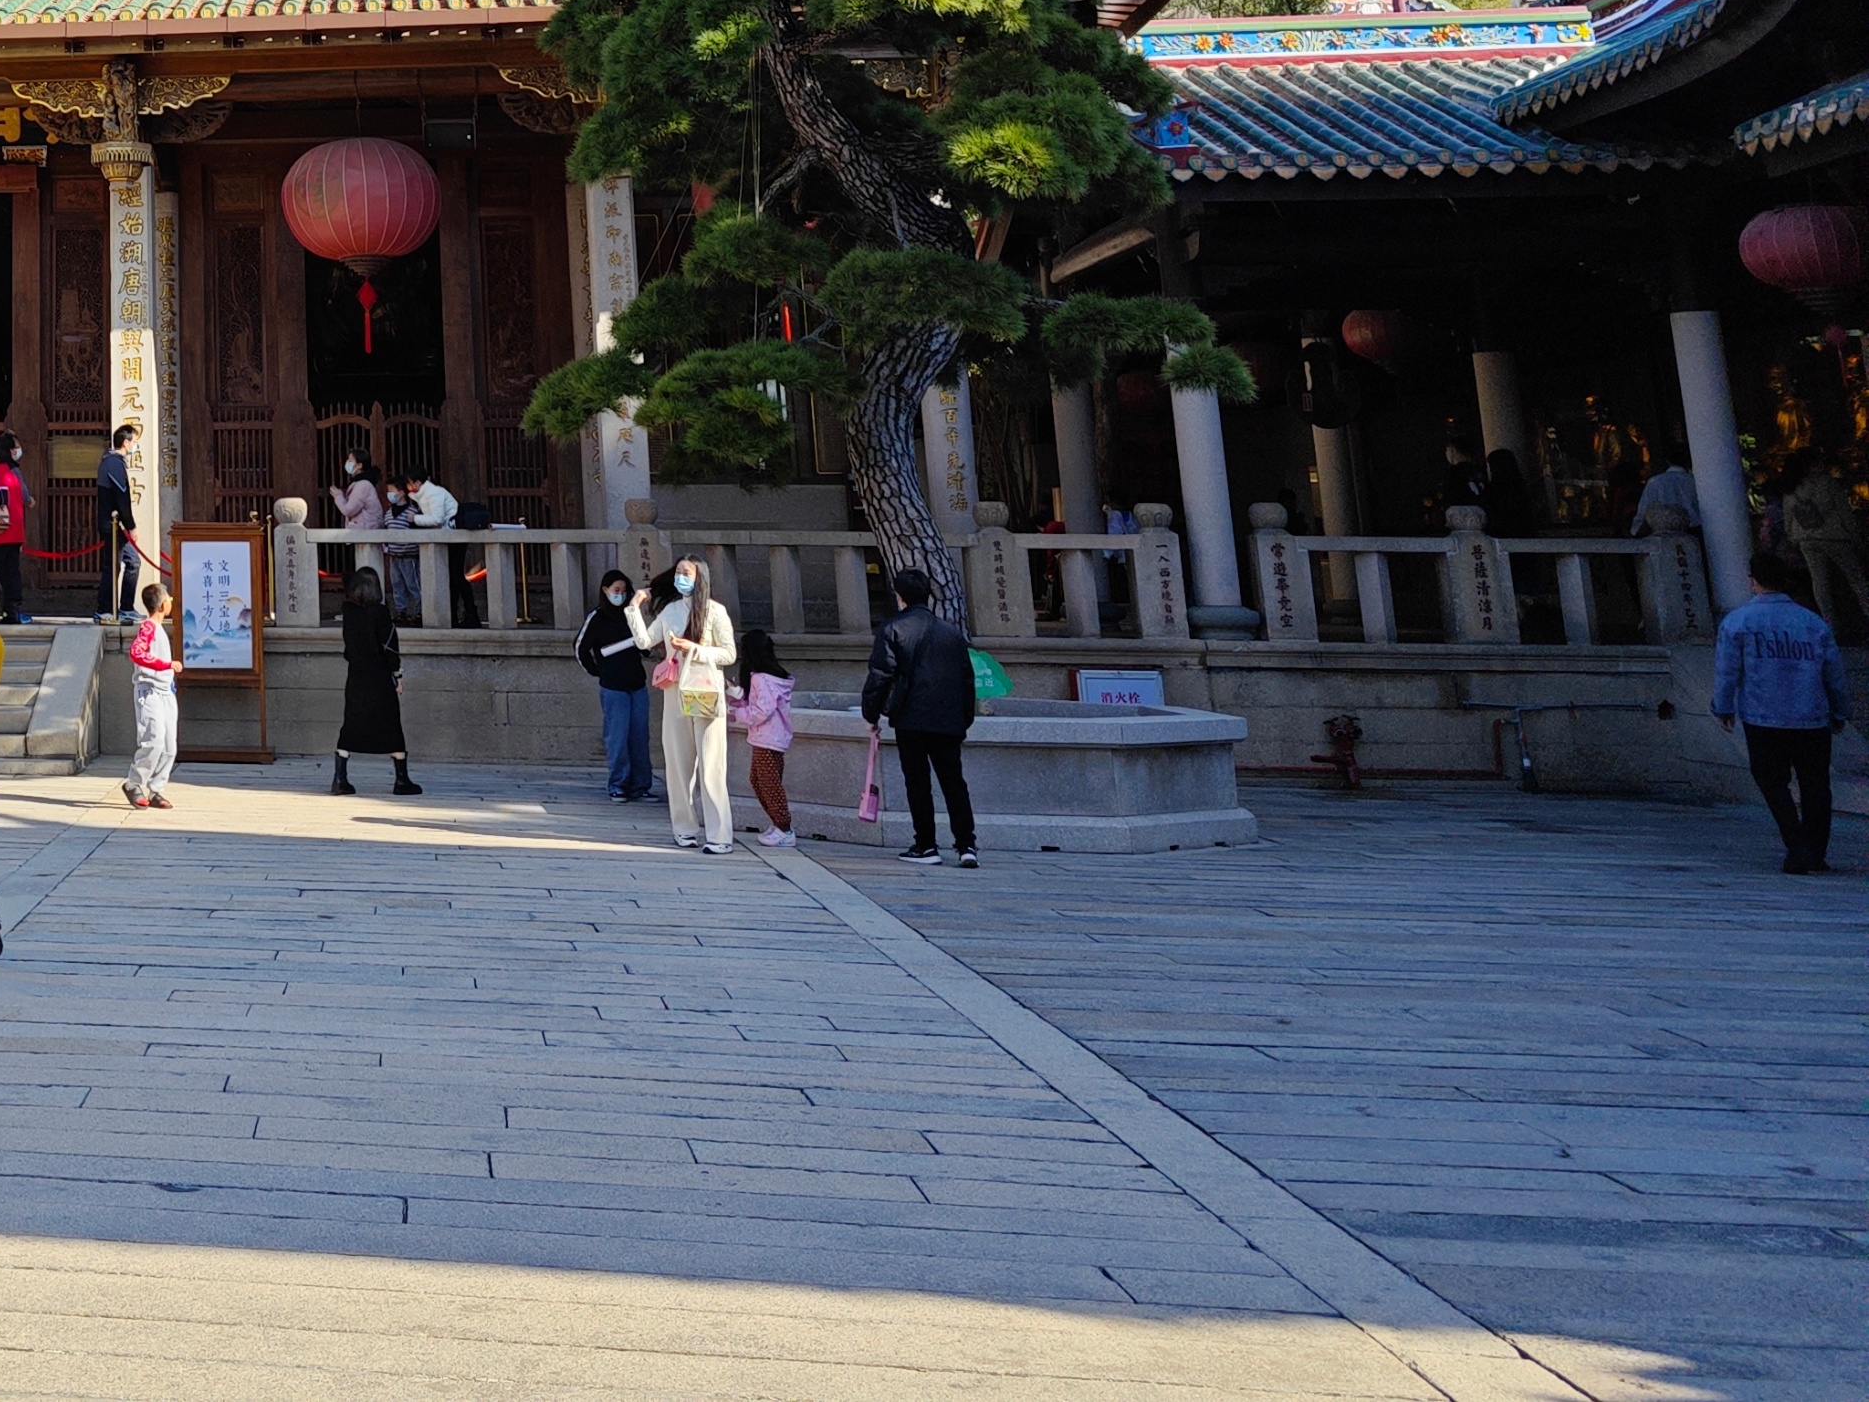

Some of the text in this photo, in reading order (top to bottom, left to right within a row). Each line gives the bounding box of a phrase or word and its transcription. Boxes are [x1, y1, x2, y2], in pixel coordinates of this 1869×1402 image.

[202, 559, 215, 633] 欢喜十方人
[218, 559, 230, 633] 文明三宝地
[1101, 691, 1141, 704] 消火栓
